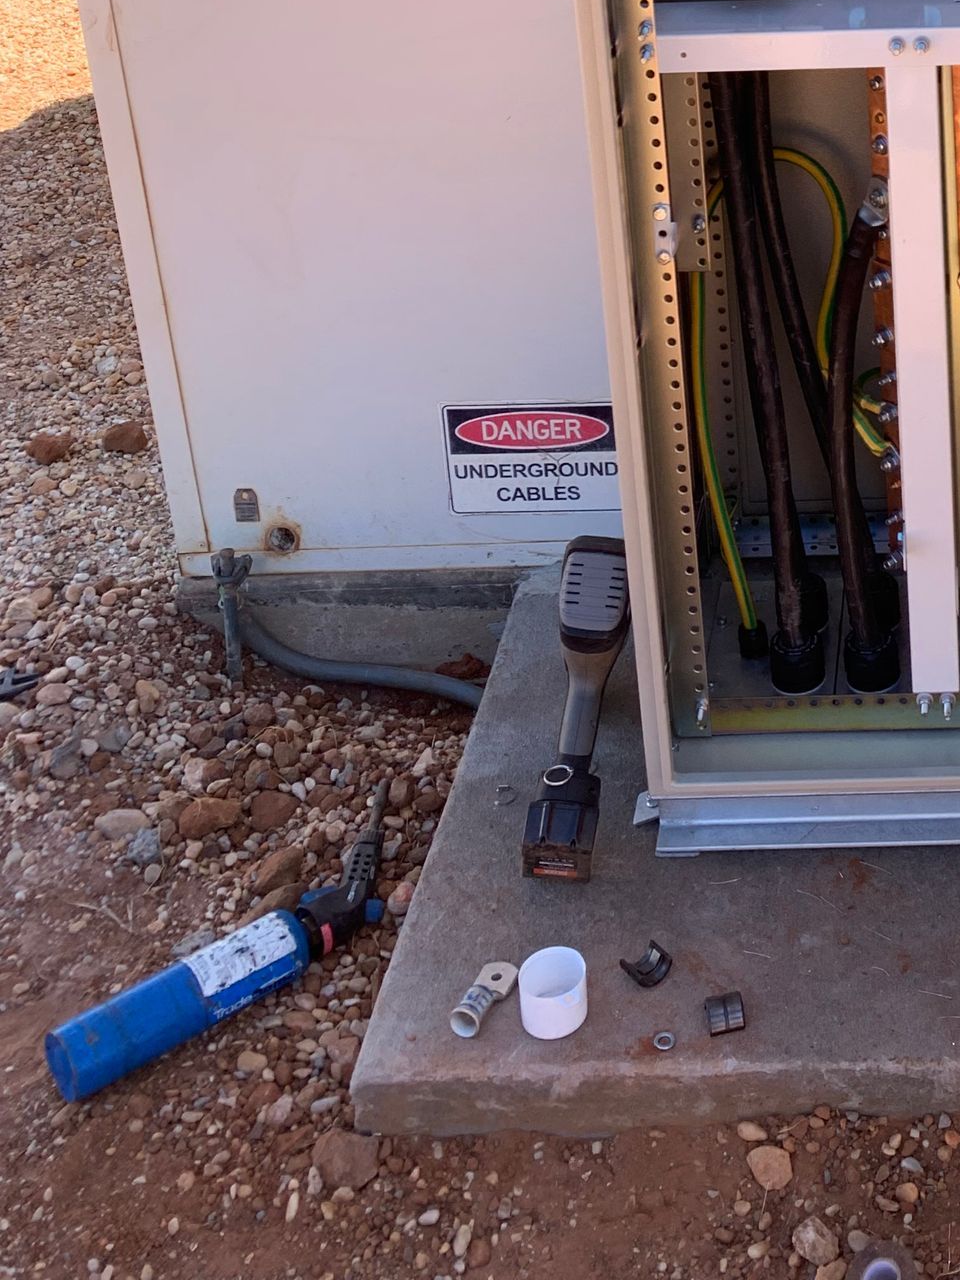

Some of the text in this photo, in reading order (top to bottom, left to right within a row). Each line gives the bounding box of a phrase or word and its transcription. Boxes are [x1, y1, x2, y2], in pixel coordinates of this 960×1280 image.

[481, 419, 582, 441] DANGER
[454, 462, 618, 479] UNDERGROUND
[497, 486, 581, 502] CABLES
